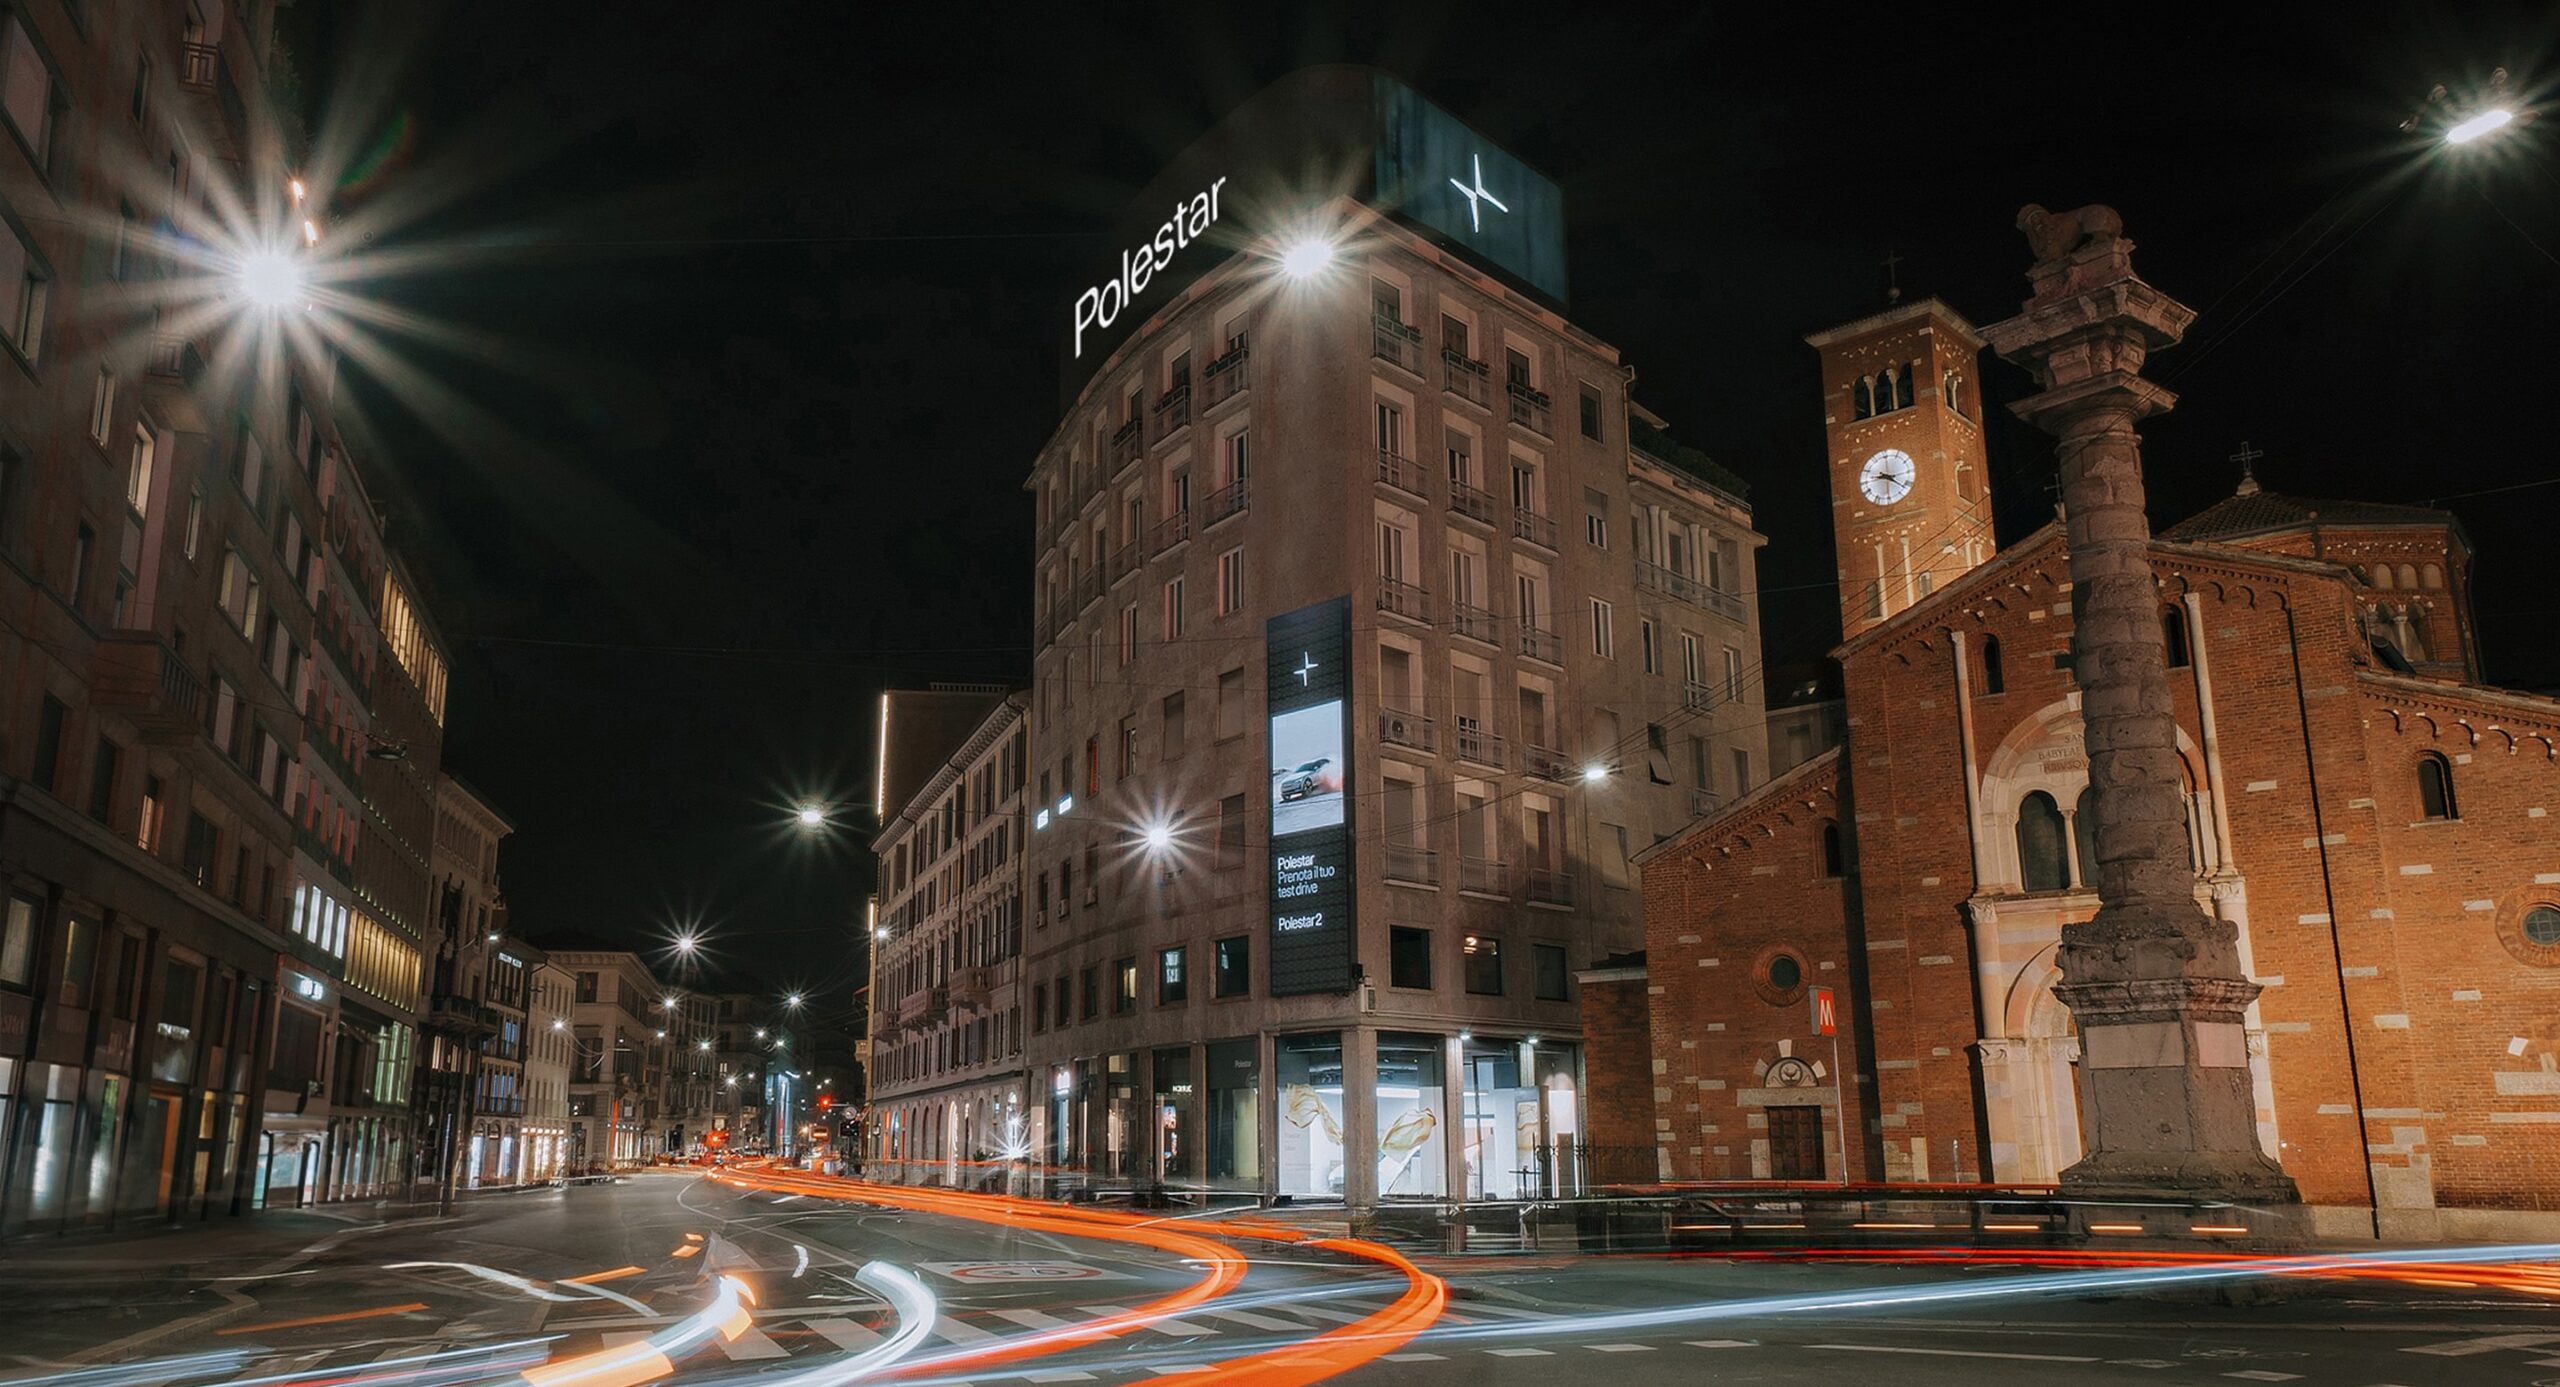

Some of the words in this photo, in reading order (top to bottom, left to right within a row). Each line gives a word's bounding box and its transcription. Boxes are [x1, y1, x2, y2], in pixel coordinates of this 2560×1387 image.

[1075, 176, 1226, 359] Polestar
[1278, 854, 1315, 871] Polestar
[1278, 868, 1313, 884] Prenota
[1313, 865, 1319, 878] il
[1319, 865, 1336, 878] tuo
[1278, 885, 1295, 898] test
[1295, 881, 1319, 896] drive
[1820, 999, 1834, 1027] M
